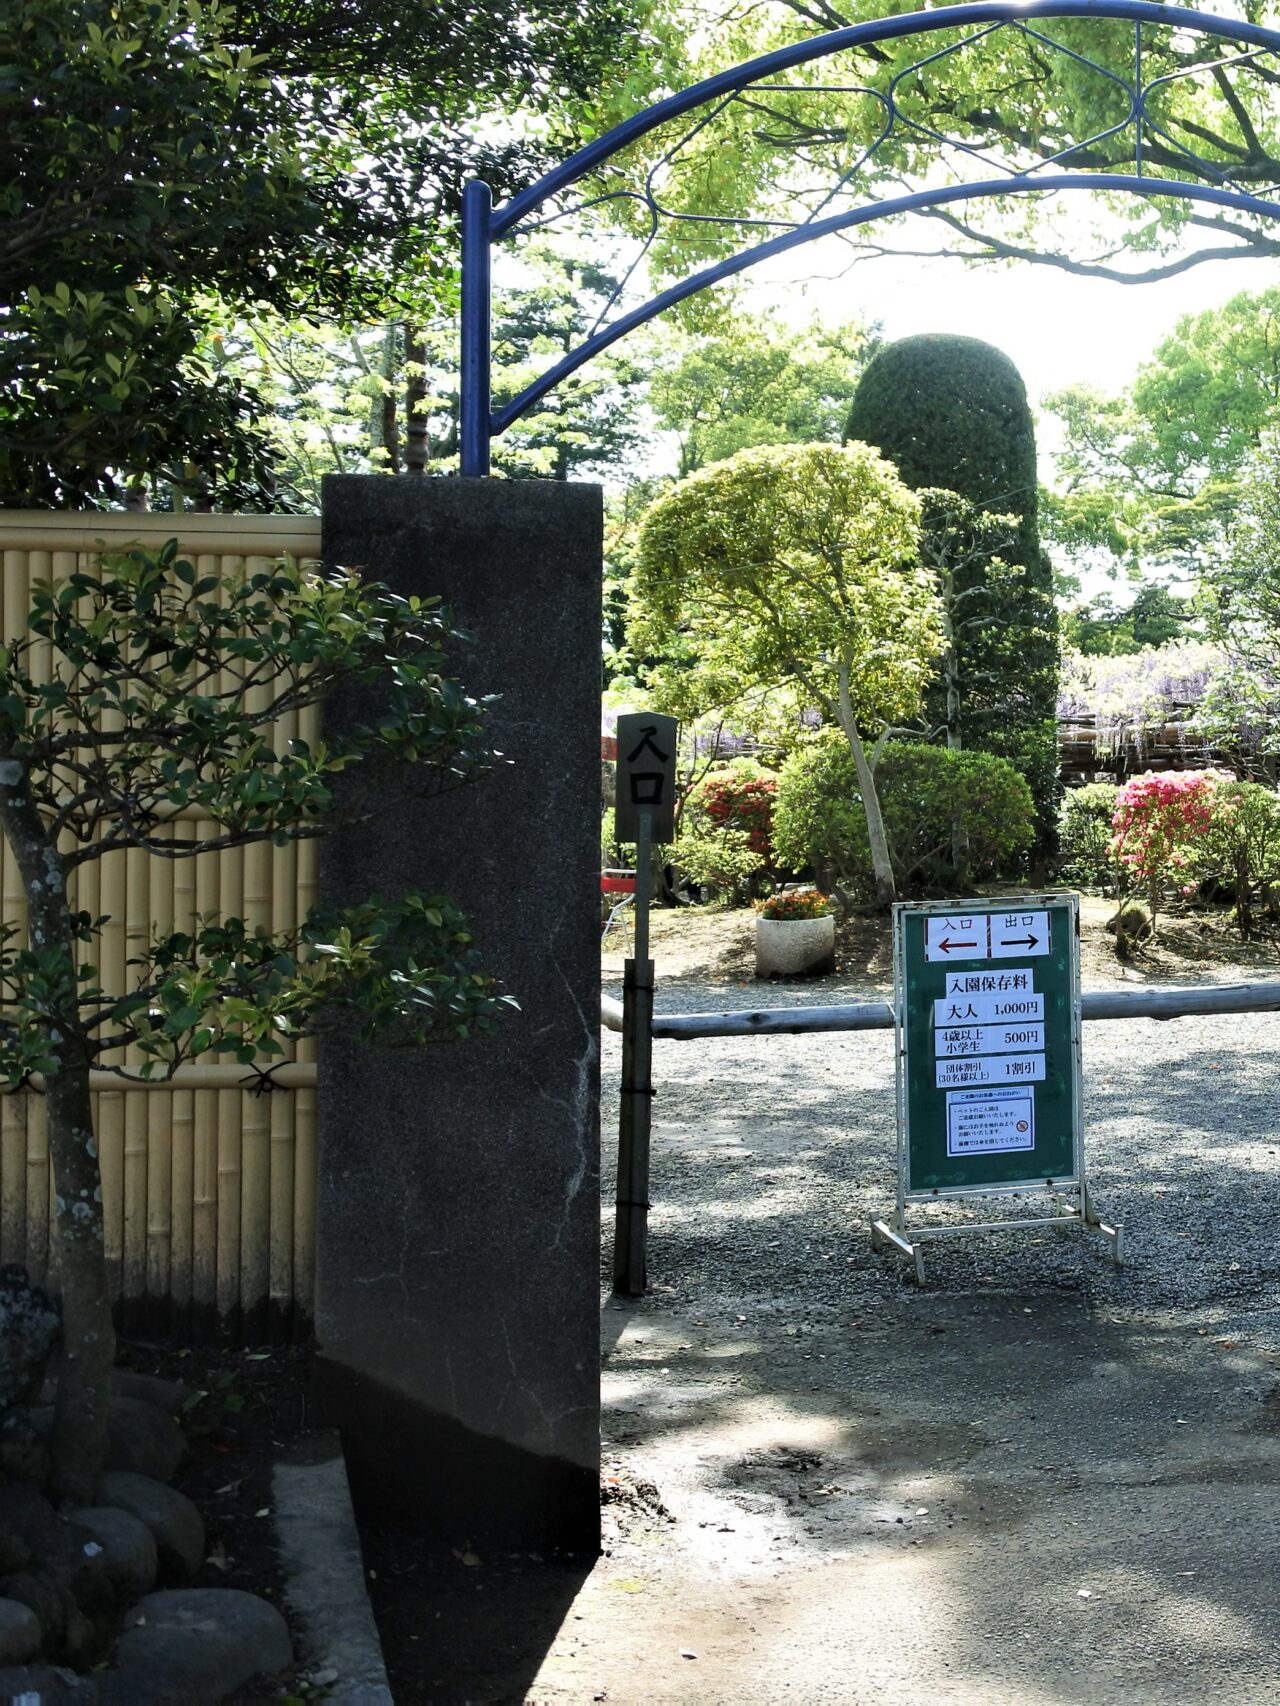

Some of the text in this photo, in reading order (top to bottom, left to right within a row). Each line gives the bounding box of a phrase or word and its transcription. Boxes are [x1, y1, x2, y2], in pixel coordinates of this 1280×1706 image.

[626, 725, 670, 805] 入口
[941, 918, 972, 931] 入口
[1005, 915, 1034, 928] 出口
[949, 974, 1029, 994] 入園保存料
[947, 1001, 1038, 1020] 大人 1,000円
[942, 1029, 984, 1042] 4歳以上
[1005, 1030, 1038, 1044] 500円
[946, 1041, 980, 1054] 小学生
[946, 1062, 981, 1074] 団体割引
[1005, 1061, 1036, 1075] 1割引
